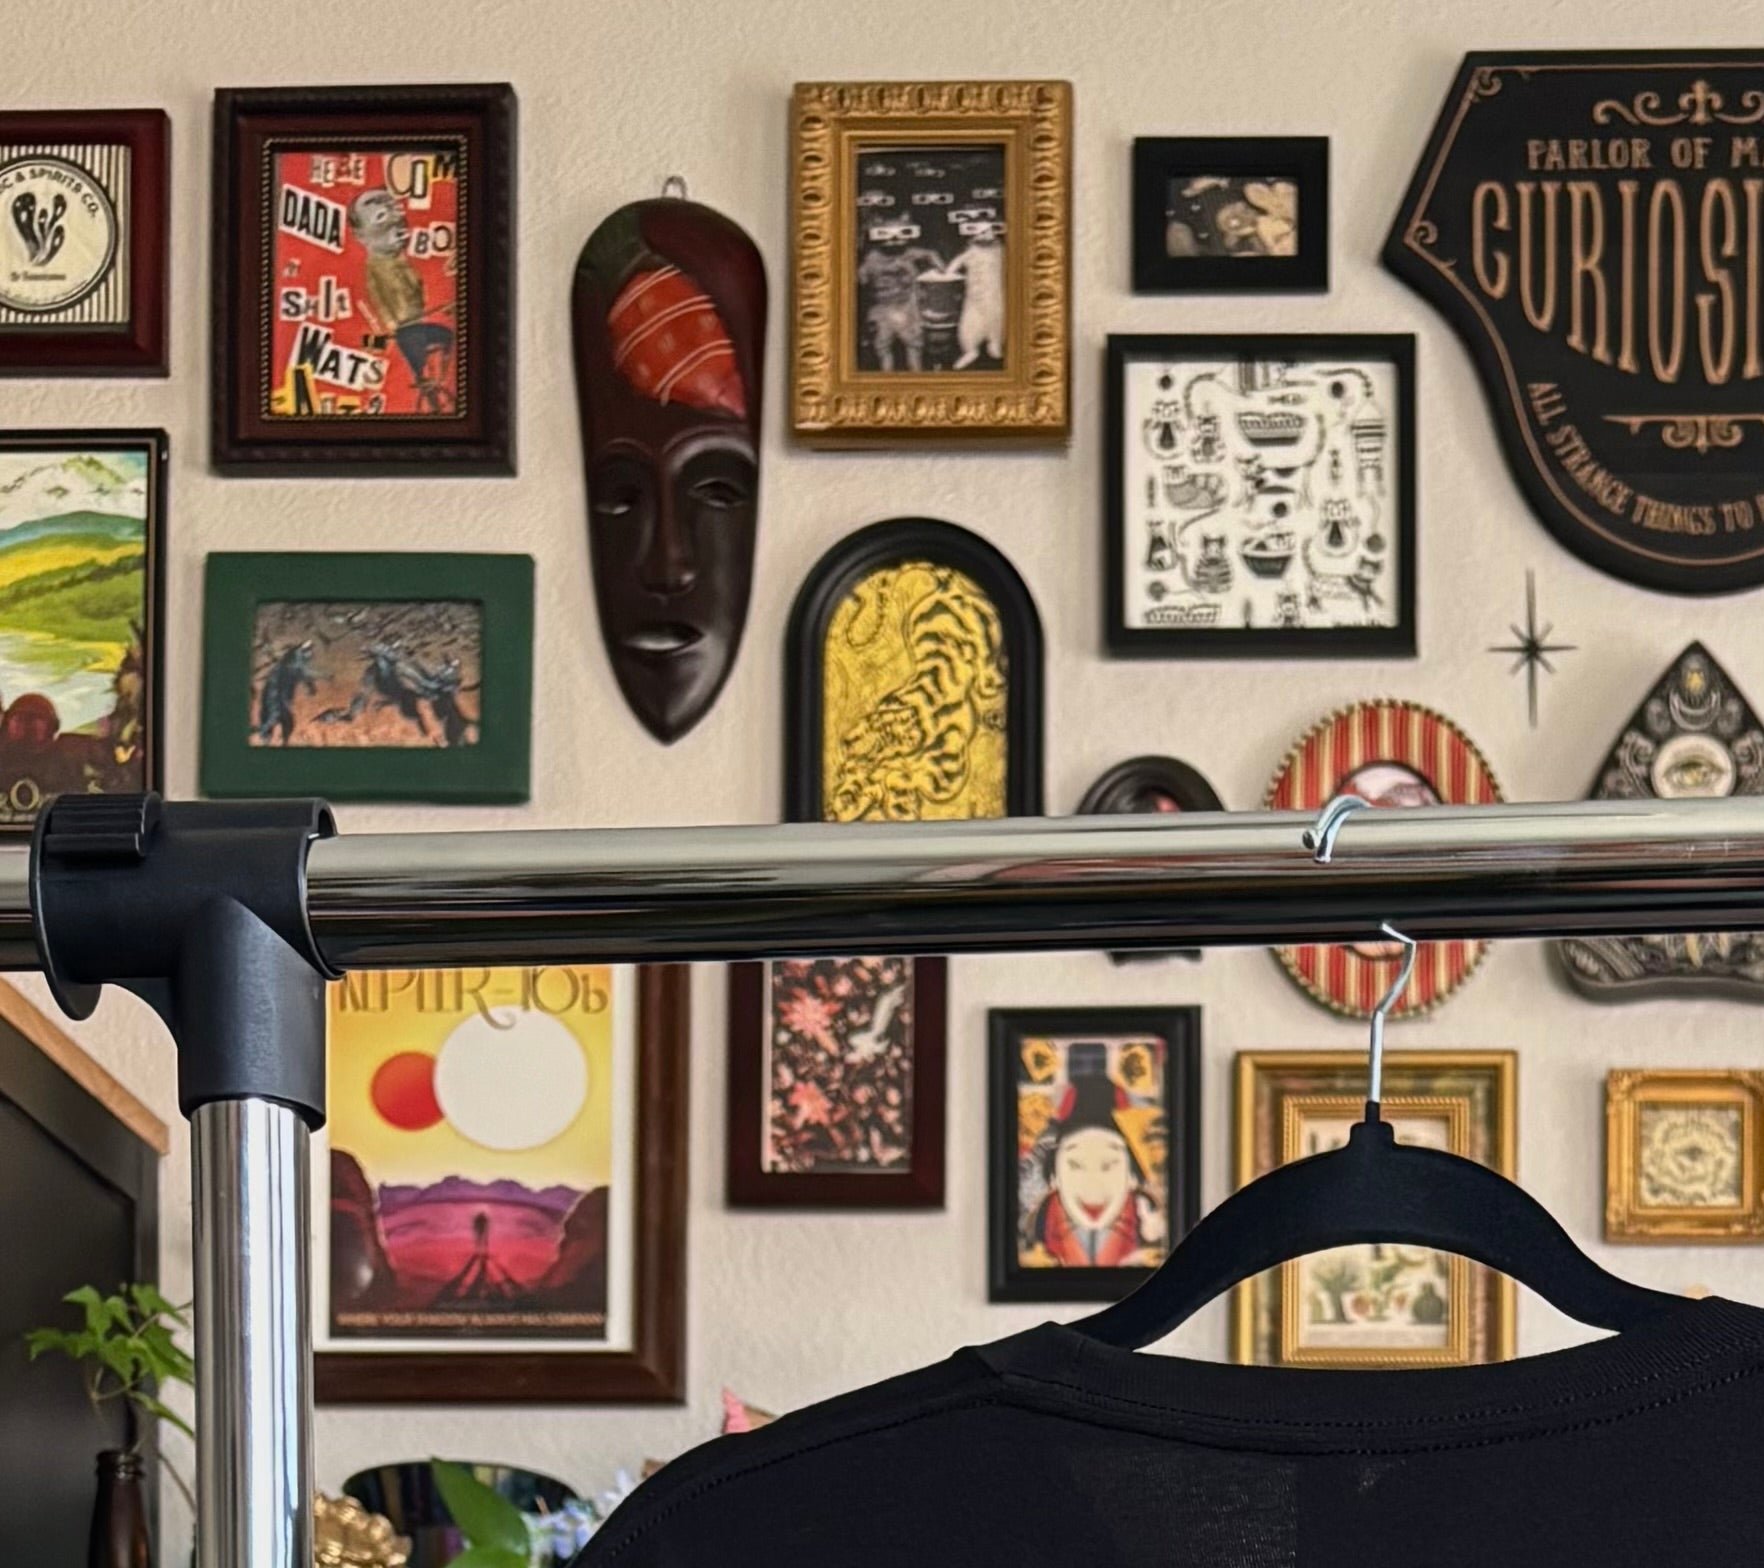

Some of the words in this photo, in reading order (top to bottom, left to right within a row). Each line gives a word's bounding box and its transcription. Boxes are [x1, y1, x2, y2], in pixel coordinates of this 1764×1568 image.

[1526, 138, 1652, 171] PARLOR
[1671, 137, 1712, 170] OF
[29, 167, 83, 193] SPIRITS
[283, 189, 341, 248] DADA
[297, 326, 385, 384] WATS
[1527, 382, 1568, 426] ALL
[1545, 424, 1635, 516] STRANGE
[1630, 495, 1717, 536] THINGS
[1718, 503, 1755, 533] TO
